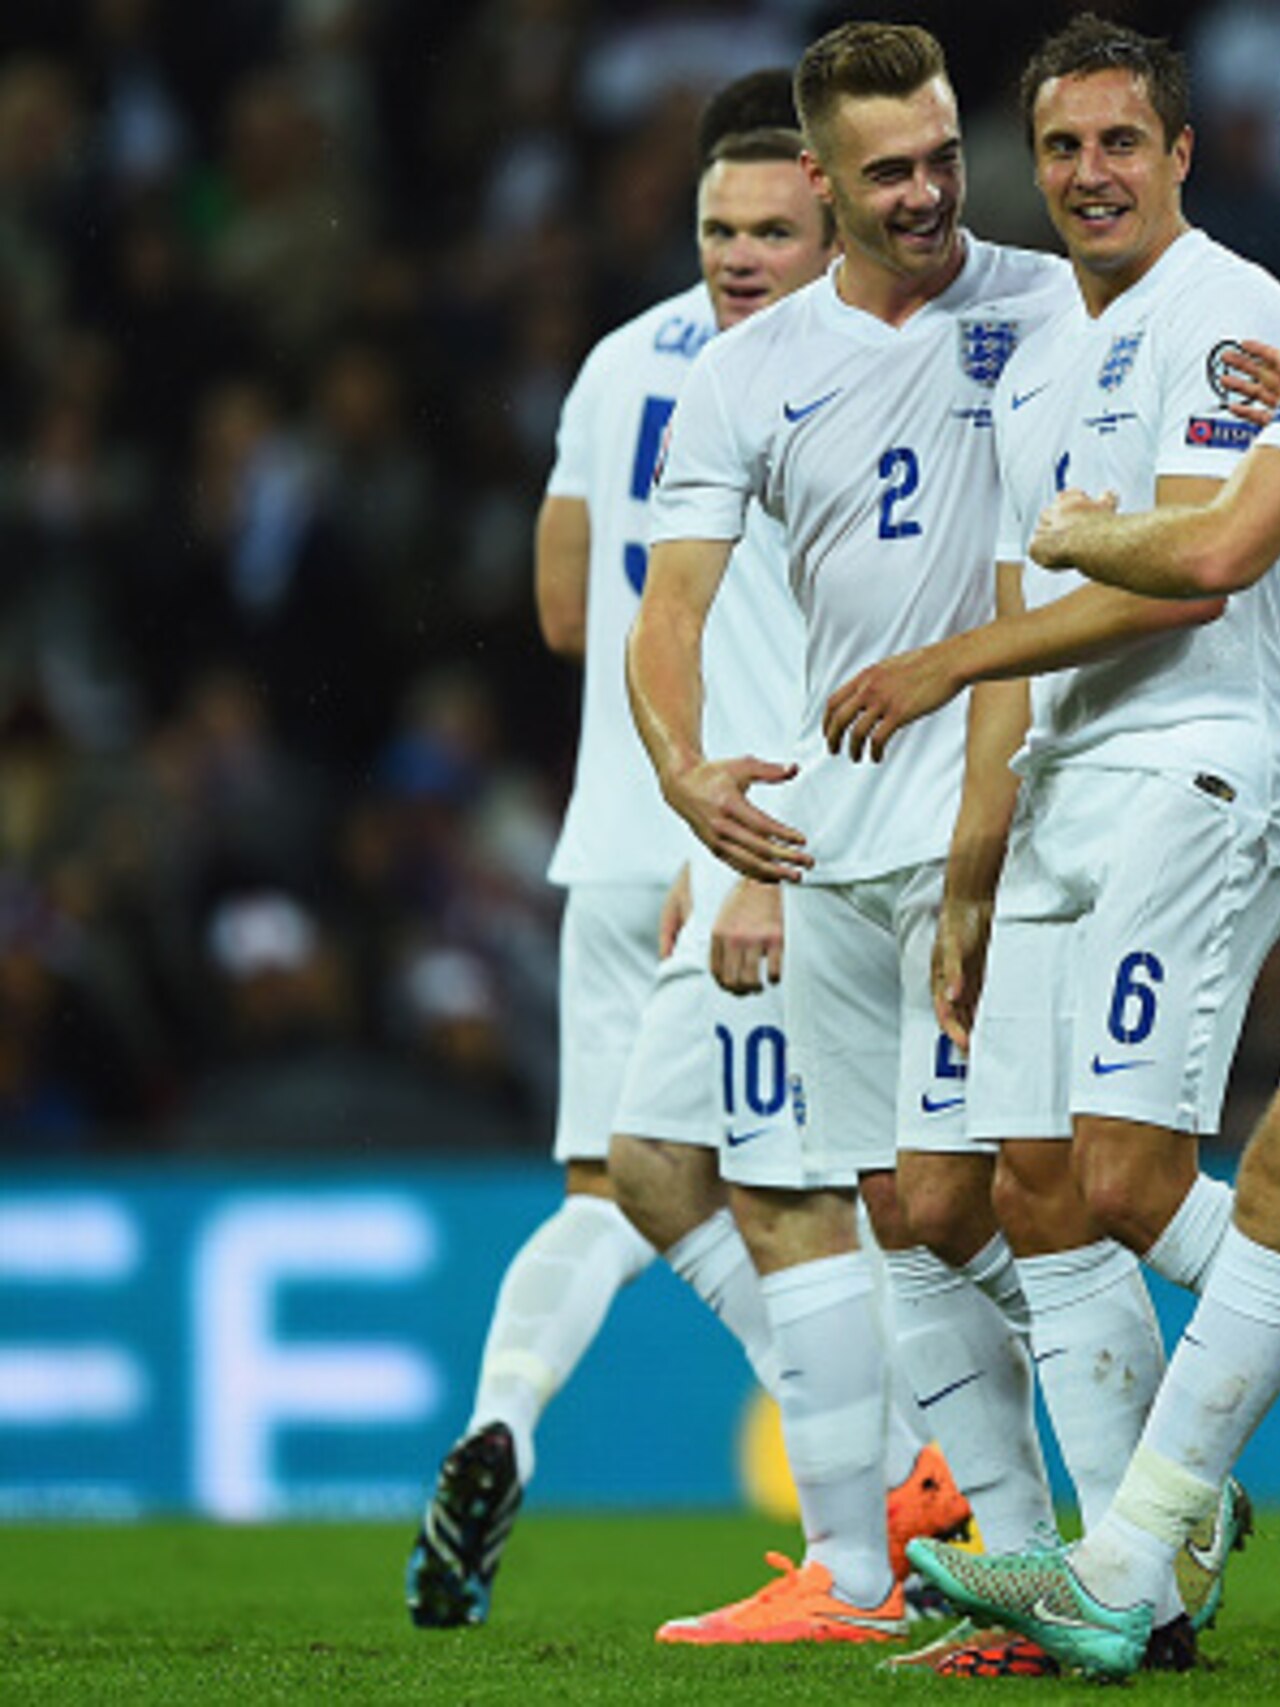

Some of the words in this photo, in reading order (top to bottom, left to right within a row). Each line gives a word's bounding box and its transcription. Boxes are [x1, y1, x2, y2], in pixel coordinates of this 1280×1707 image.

[877, 446, 922, 540] 2
[1107, 951, 1164, 1044] 6
[715, 1024, 787, 1117] 10
